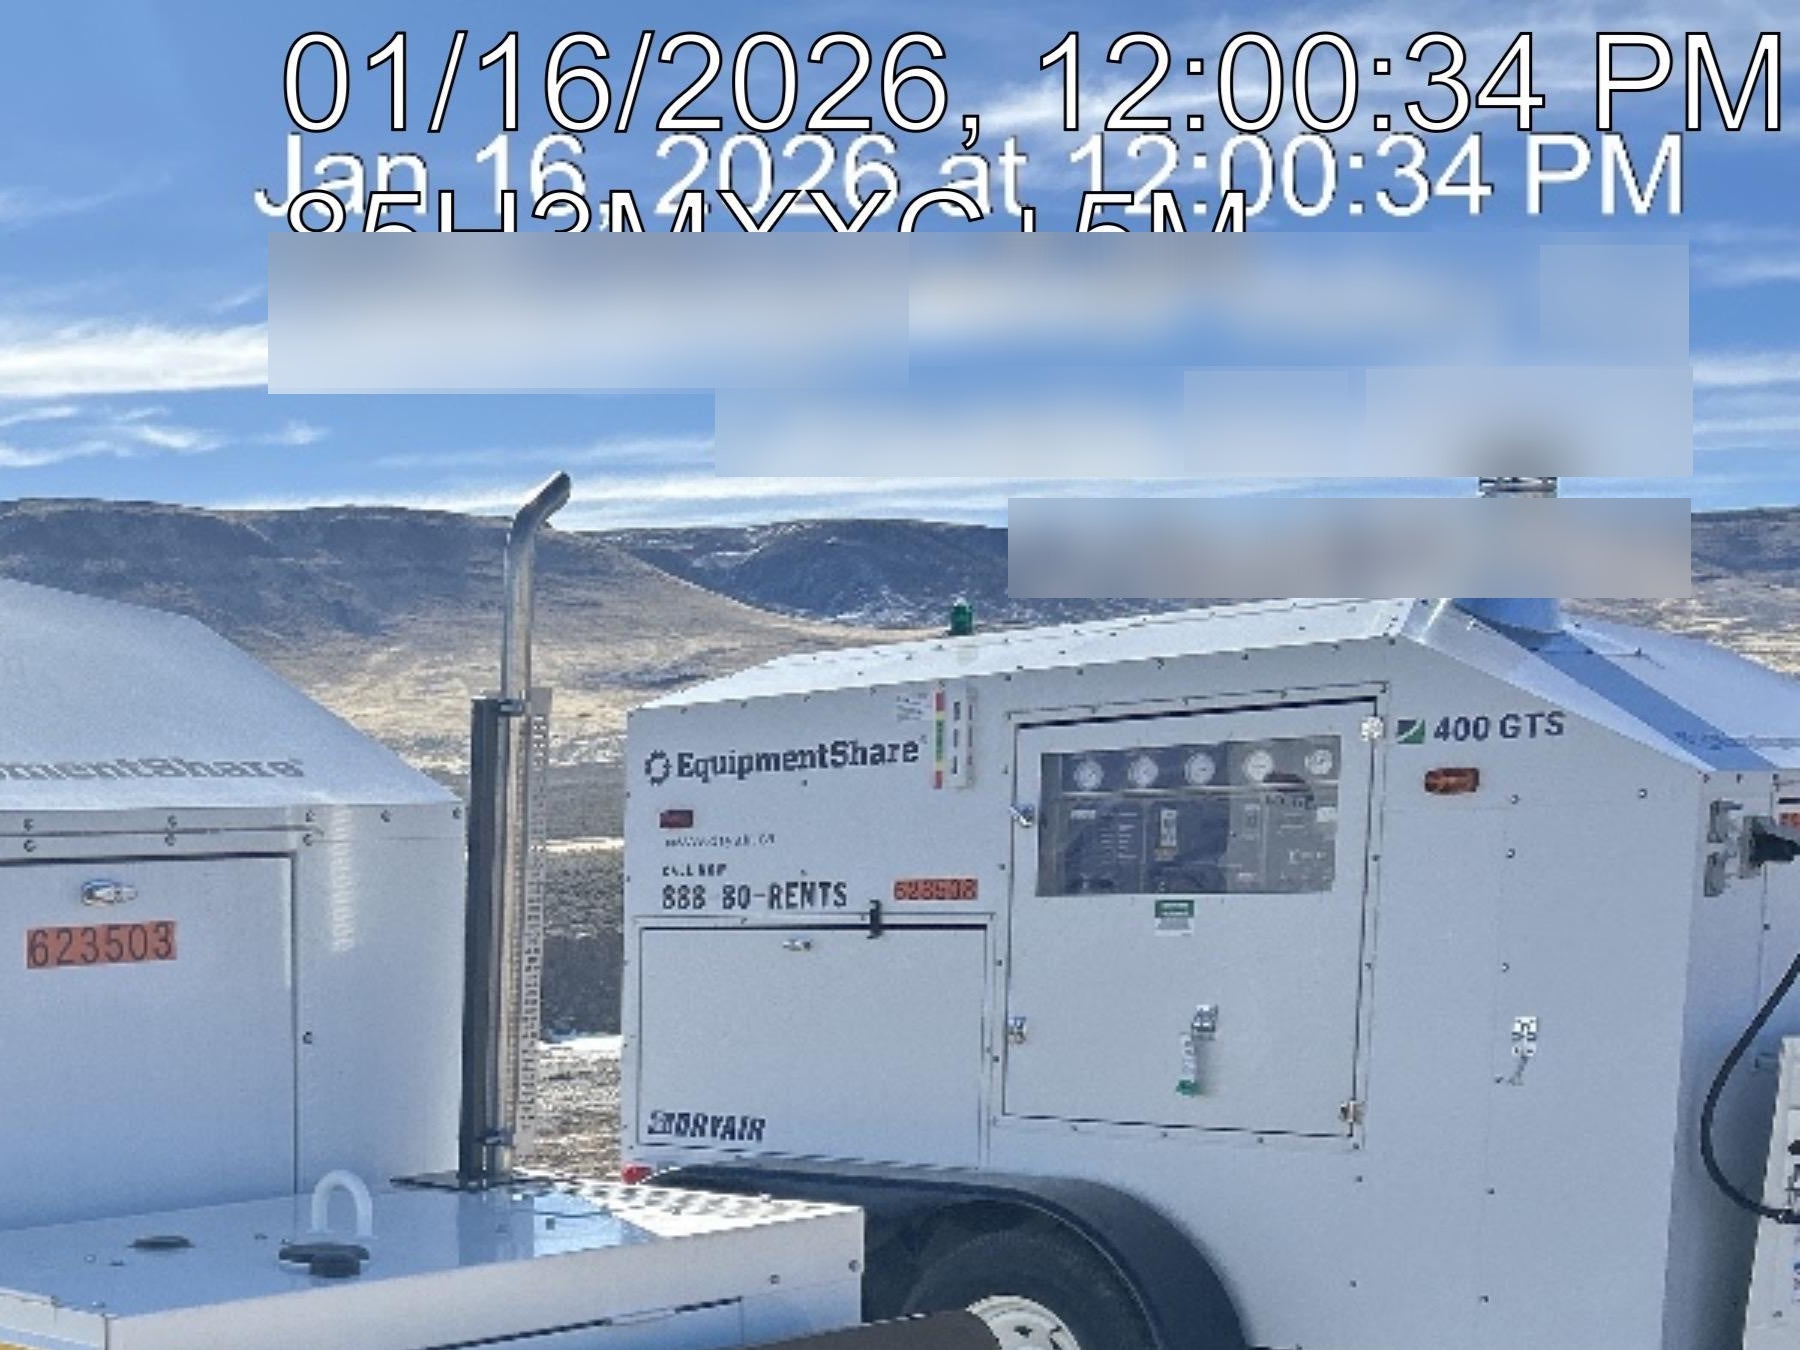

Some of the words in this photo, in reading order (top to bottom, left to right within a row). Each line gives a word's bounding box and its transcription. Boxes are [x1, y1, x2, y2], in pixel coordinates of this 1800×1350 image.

[1433, 715, 1491, 742] 400
[1499, 710, 1567, 739] GTS
[677, 740, 919, 782] EquipmentShare
[30, 921, 172, 967] 623503
